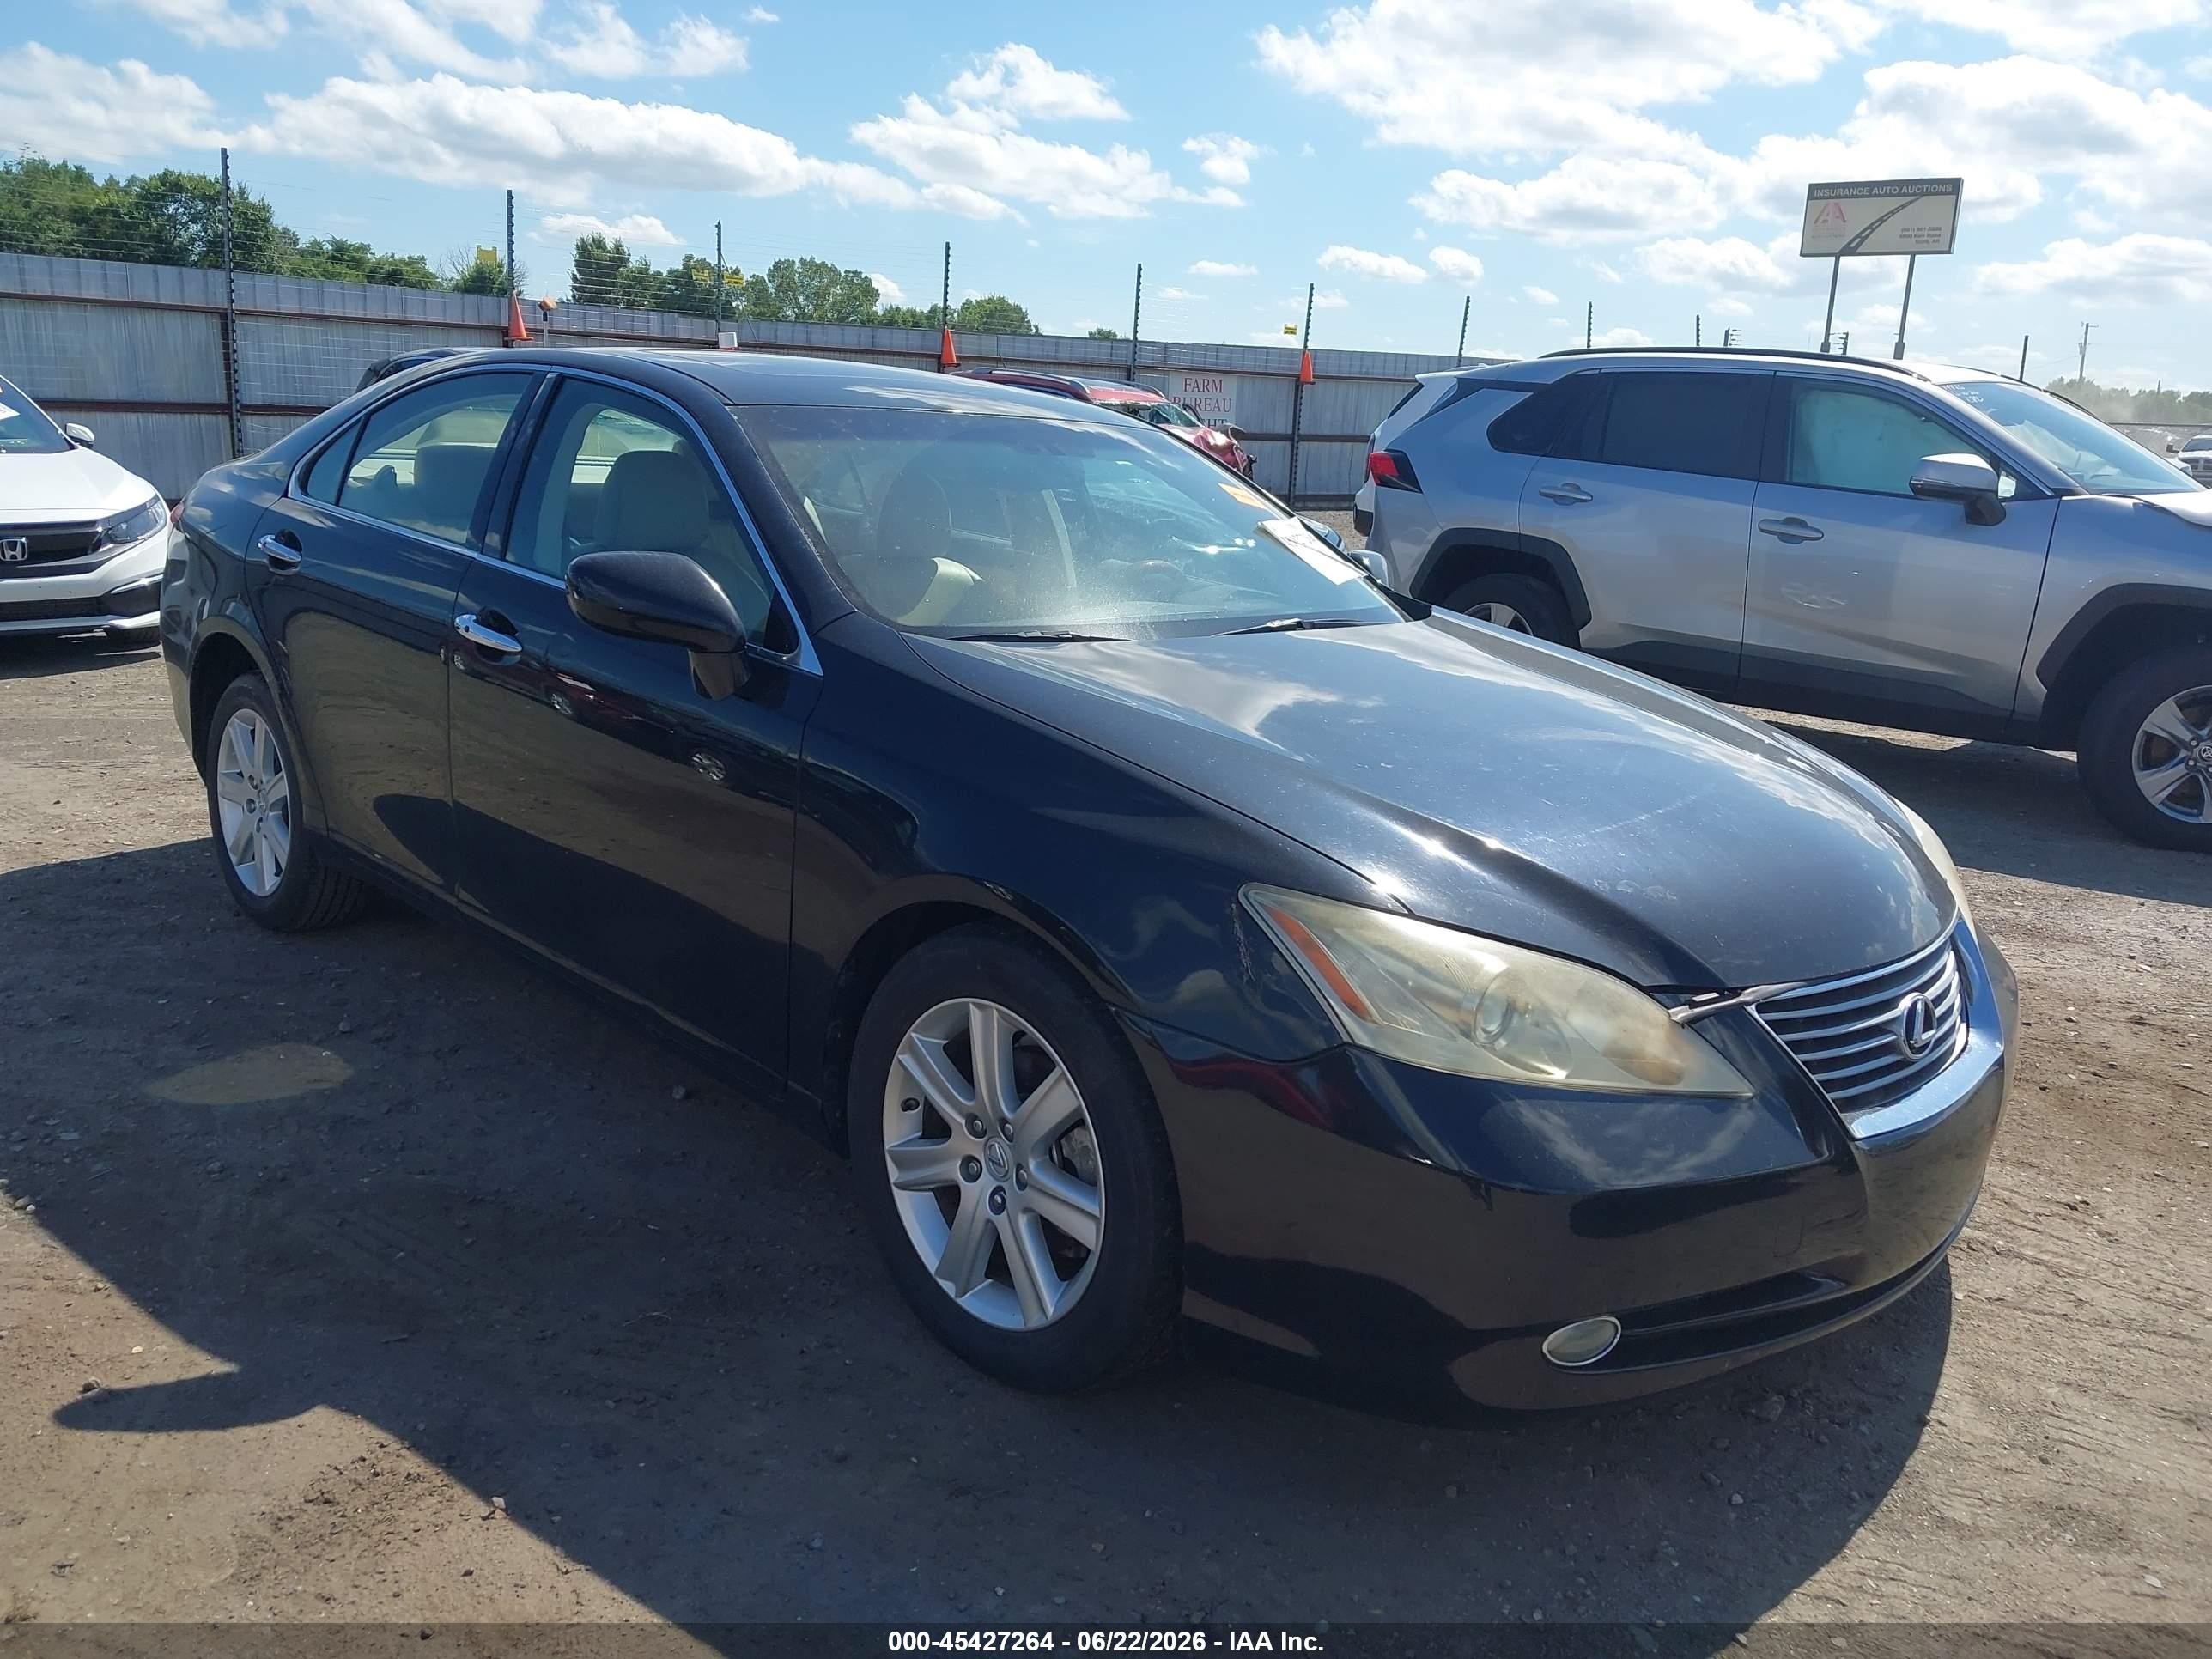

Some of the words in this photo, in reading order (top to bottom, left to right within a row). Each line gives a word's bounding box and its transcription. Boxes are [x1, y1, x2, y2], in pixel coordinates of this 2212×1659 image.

[1814, 186, 1870, 198] INSURANCE
[1872, 185, 1899, 196] AUTO
[1900, 184, 1953, 194] AUCTIONS
[1183, 377, 1223, 393] FARM
